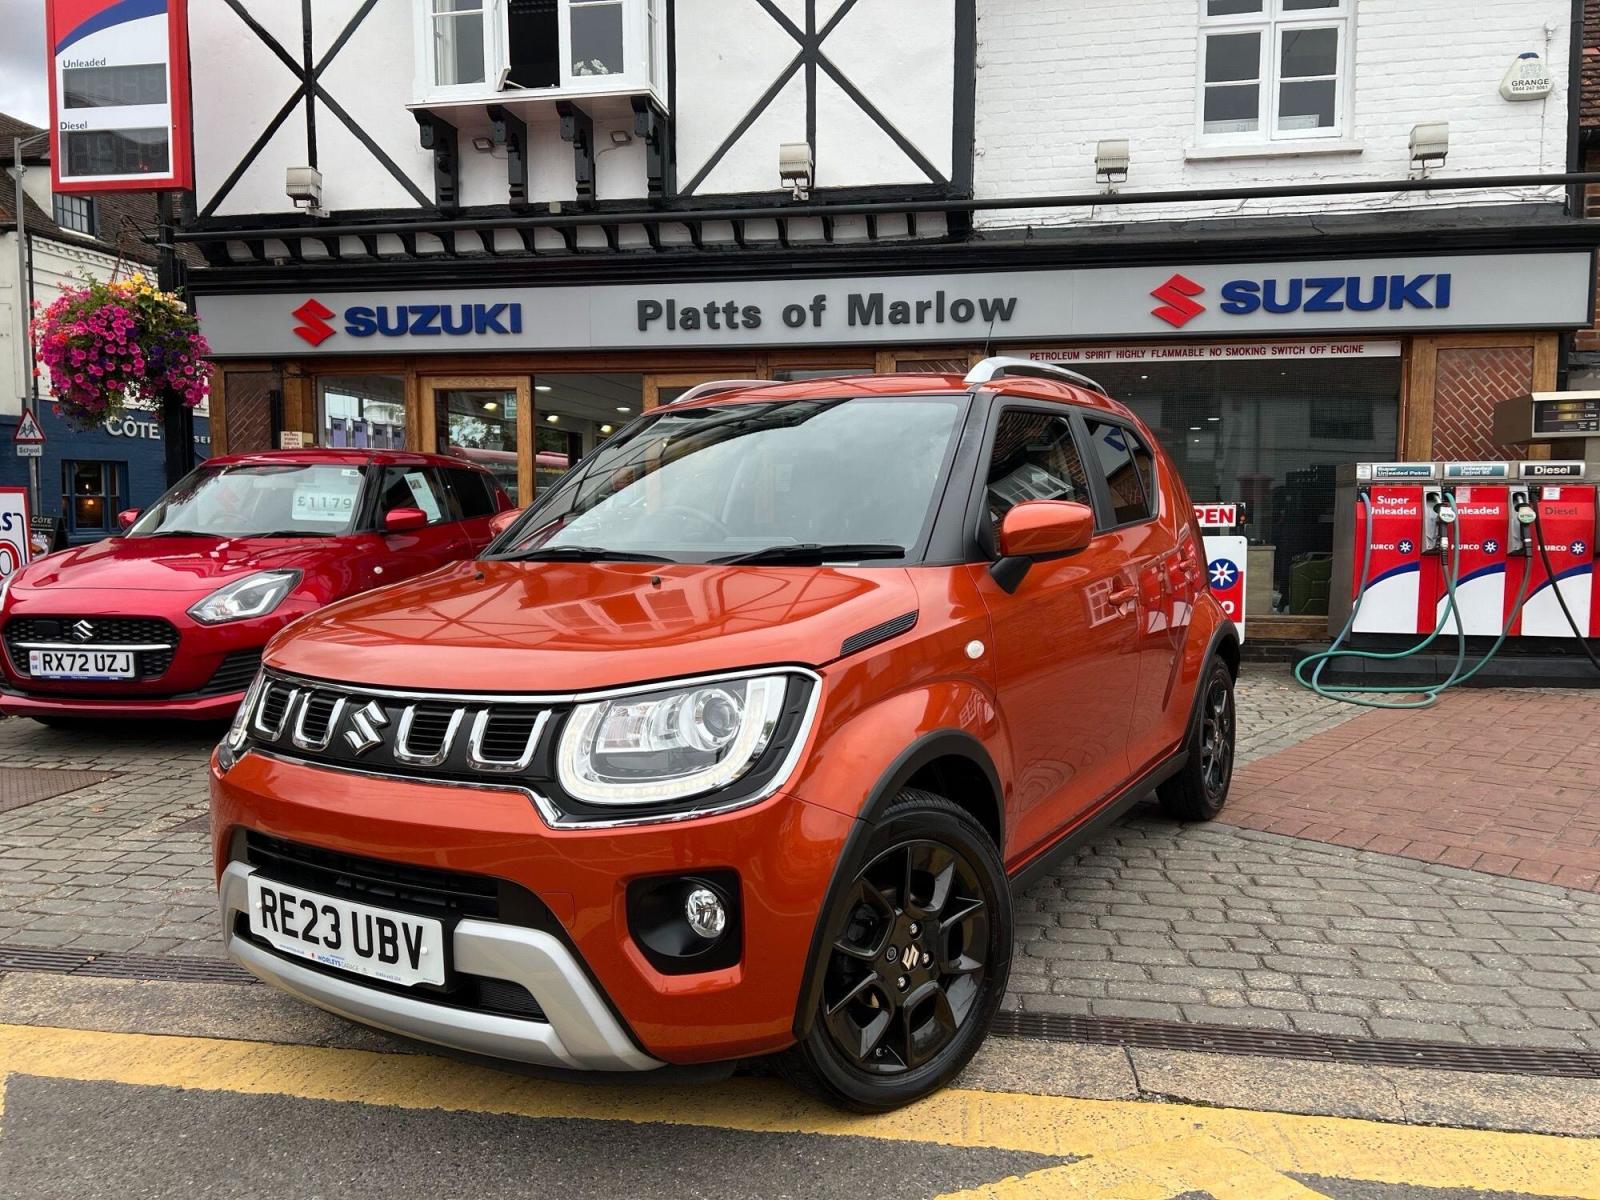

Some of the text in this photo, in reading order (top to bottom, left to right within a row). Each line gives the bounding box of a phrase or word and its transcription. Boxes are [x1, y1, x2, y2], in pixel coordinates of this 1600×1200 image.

[63, 57, 106, 68] Unleaded
[1512, 79, 1550, 87] GRANGE
[60, 121, 88, 130] Diesel
[1220, 273, 1451, 315] SUZUKI
[637, 290, 1018, 332] Platts of Marlow
[344, 302, 522, 337] SUZUKI
[1030, 344, 1364, 361] PETROLEUM SPIRIT HIGHLY FLAMMABLE NO SMOKING SWITCH OFF ENGINE
[104, 415, 160, 440] CÔTE
[19, 446, 40, 454] School
[1534, 466, 1571, 475] Diesel
[1377, 495, 1410, 505] Super
[1195, 508, 1234, 524] PEN
[1458, 506, 1499, 515] nleaded
[1545, 507, 1578, 515] Diesel
[42, 653, 130, 673] RX72 UZJ
[260, 886, 423, 970] RE23 UBV
